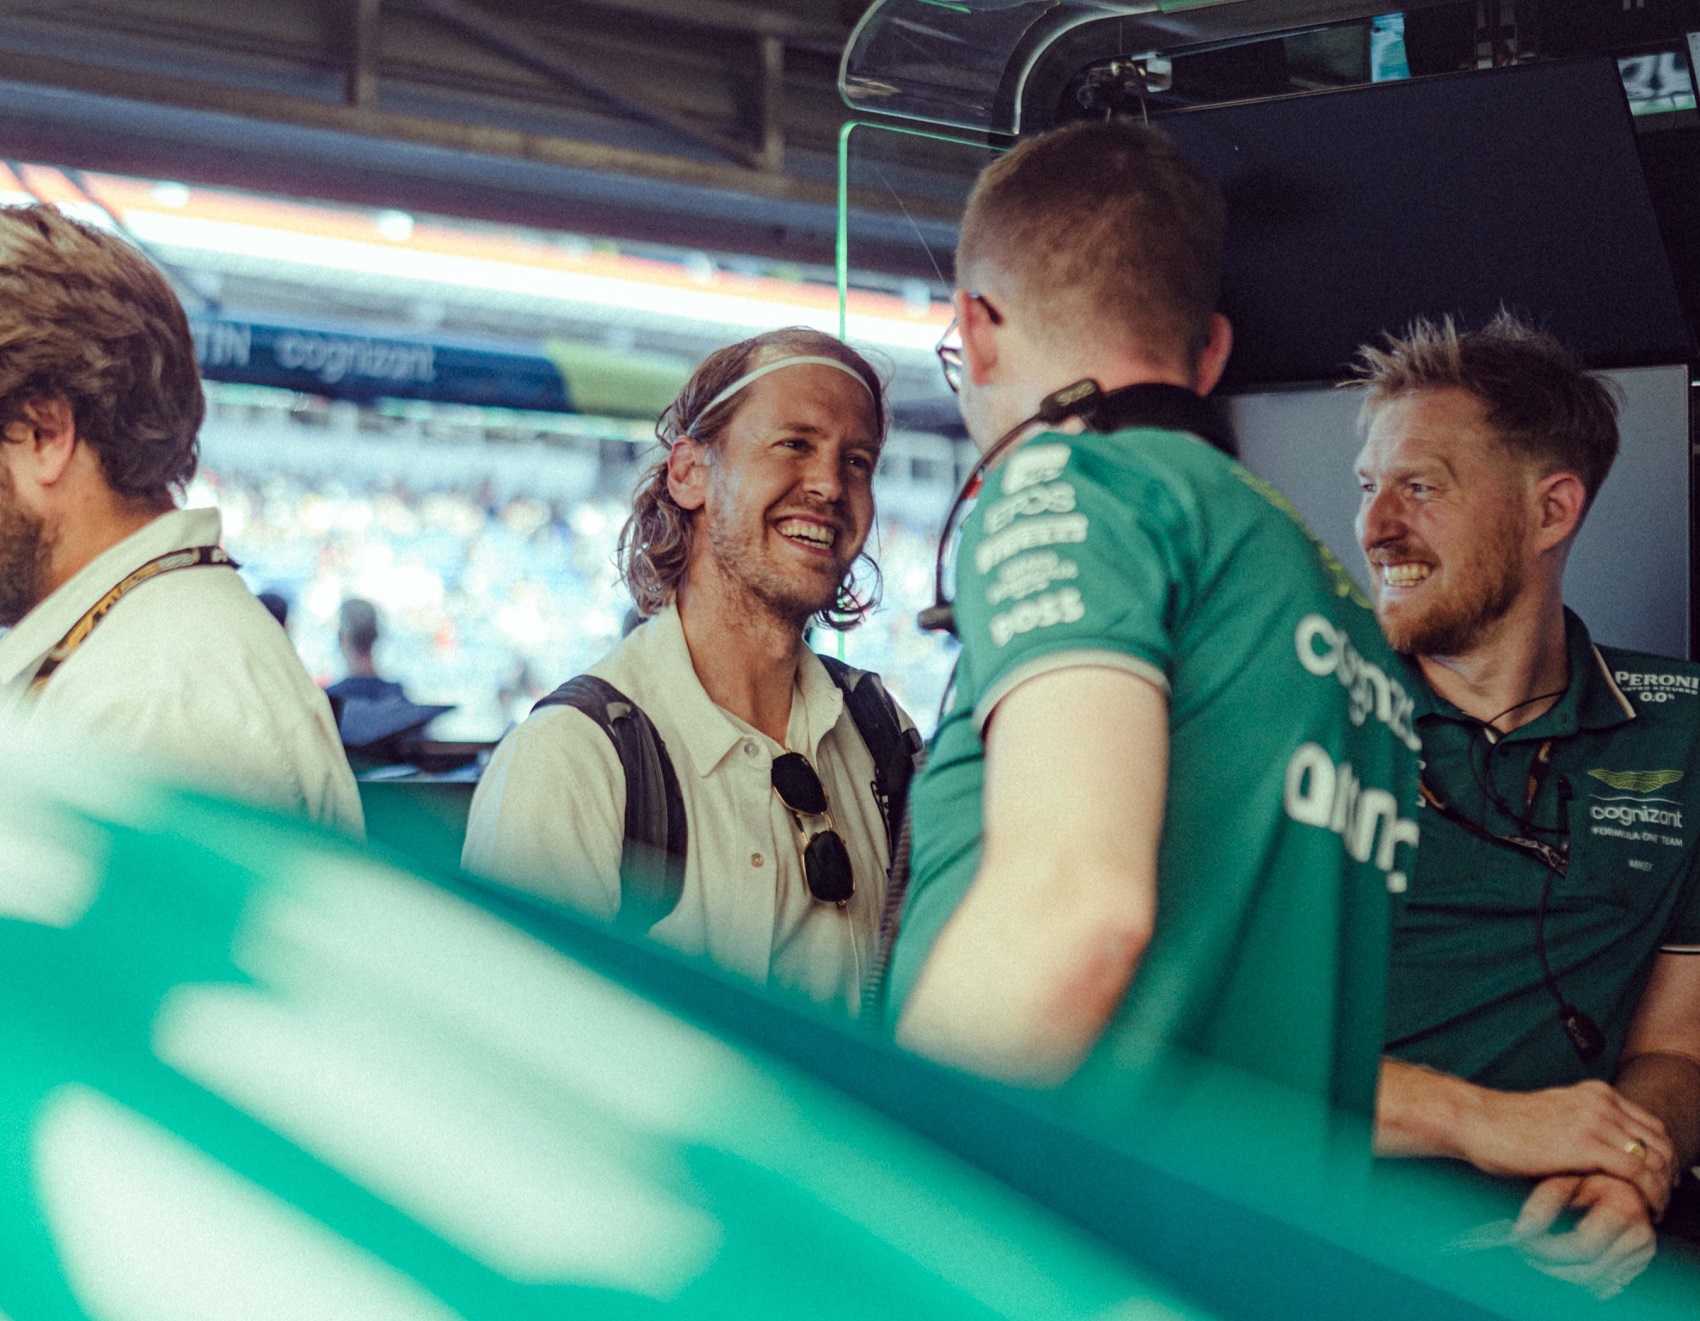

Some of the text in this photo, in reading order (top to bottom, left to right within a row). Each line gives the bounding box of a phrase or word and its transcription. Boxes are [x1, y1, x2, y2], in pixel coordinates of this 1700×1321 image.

[1615, 671, 1699, 689] PERONI
[1590, 805, 1683, 828] cognizant
[1591, 827, 1640, 840] FORMULA
[1661, 835, 1683, 847] TEAM
